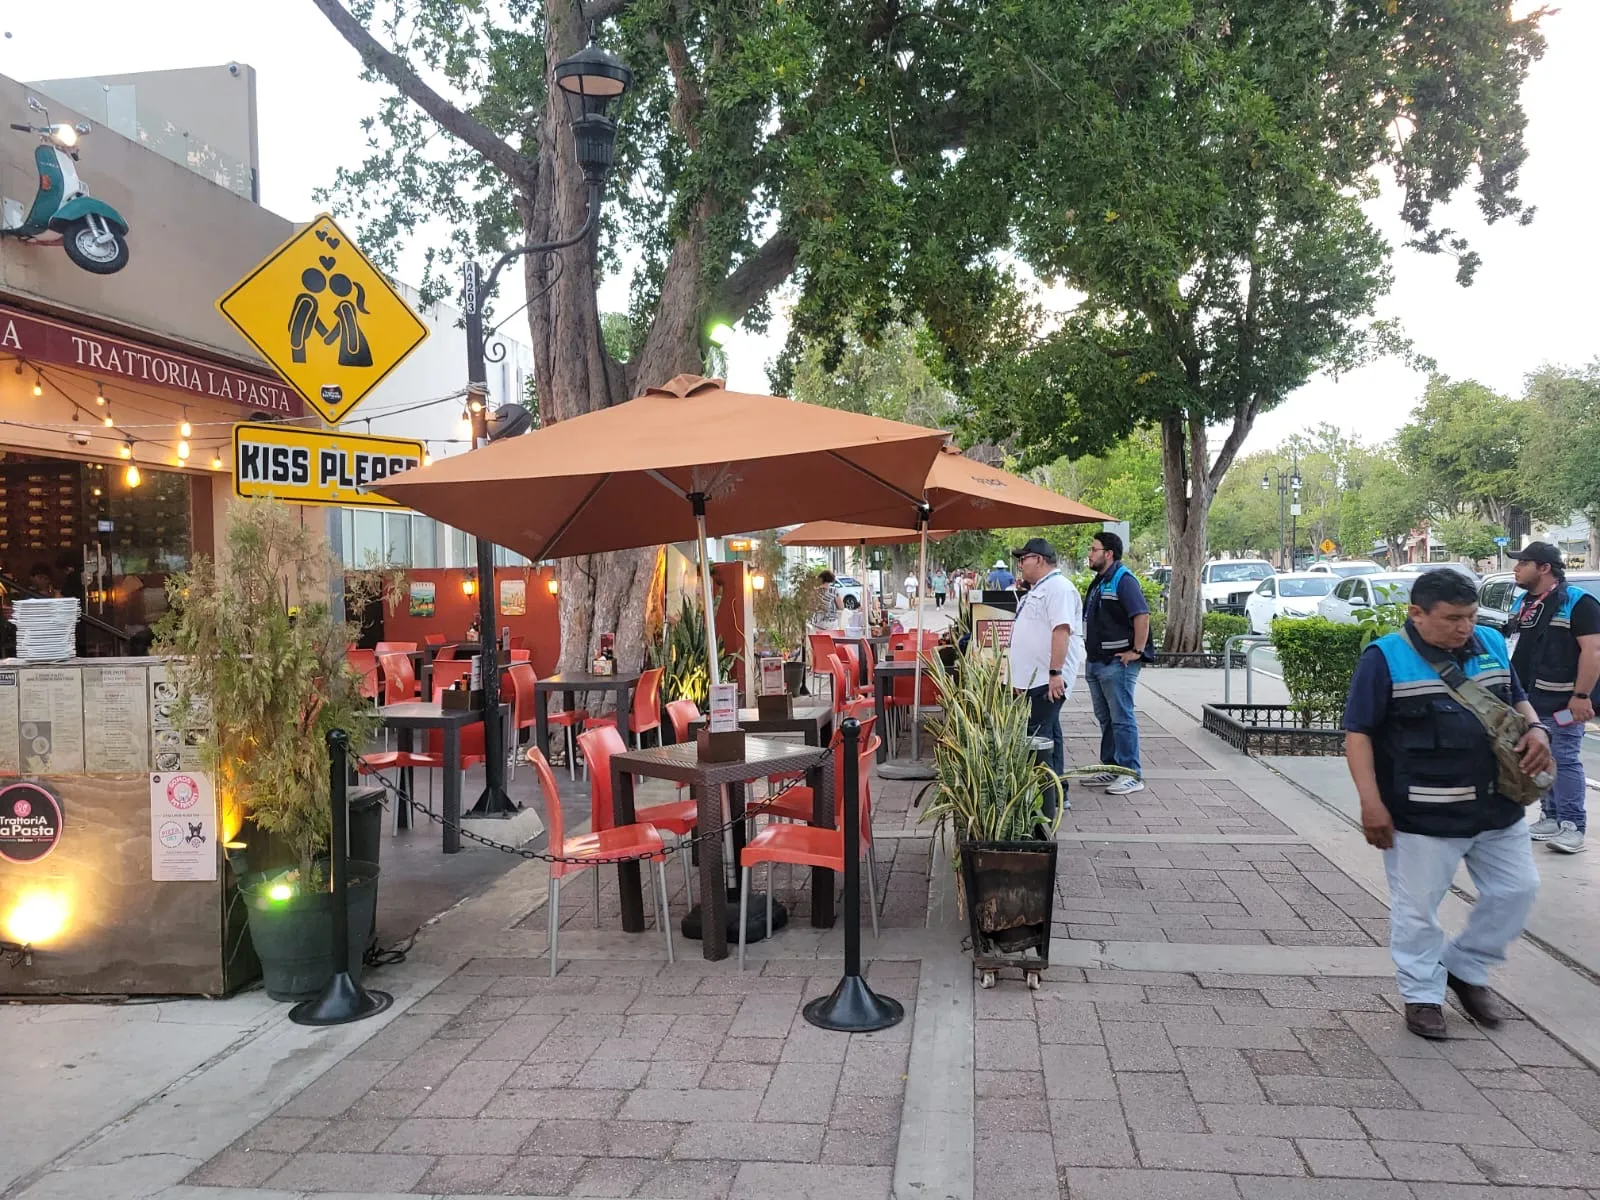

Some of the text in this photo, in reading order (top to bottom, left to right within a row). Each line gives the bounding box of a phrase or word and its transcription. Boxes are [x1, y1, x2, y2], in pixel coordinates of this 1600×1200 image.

[466, 263, 475, 312] A4203
[72, 336, 290, 412] TRATTORIA LA PASTA
[240, 443, 309, 485] KISS
[12, 824, 54, 836] Pasta
